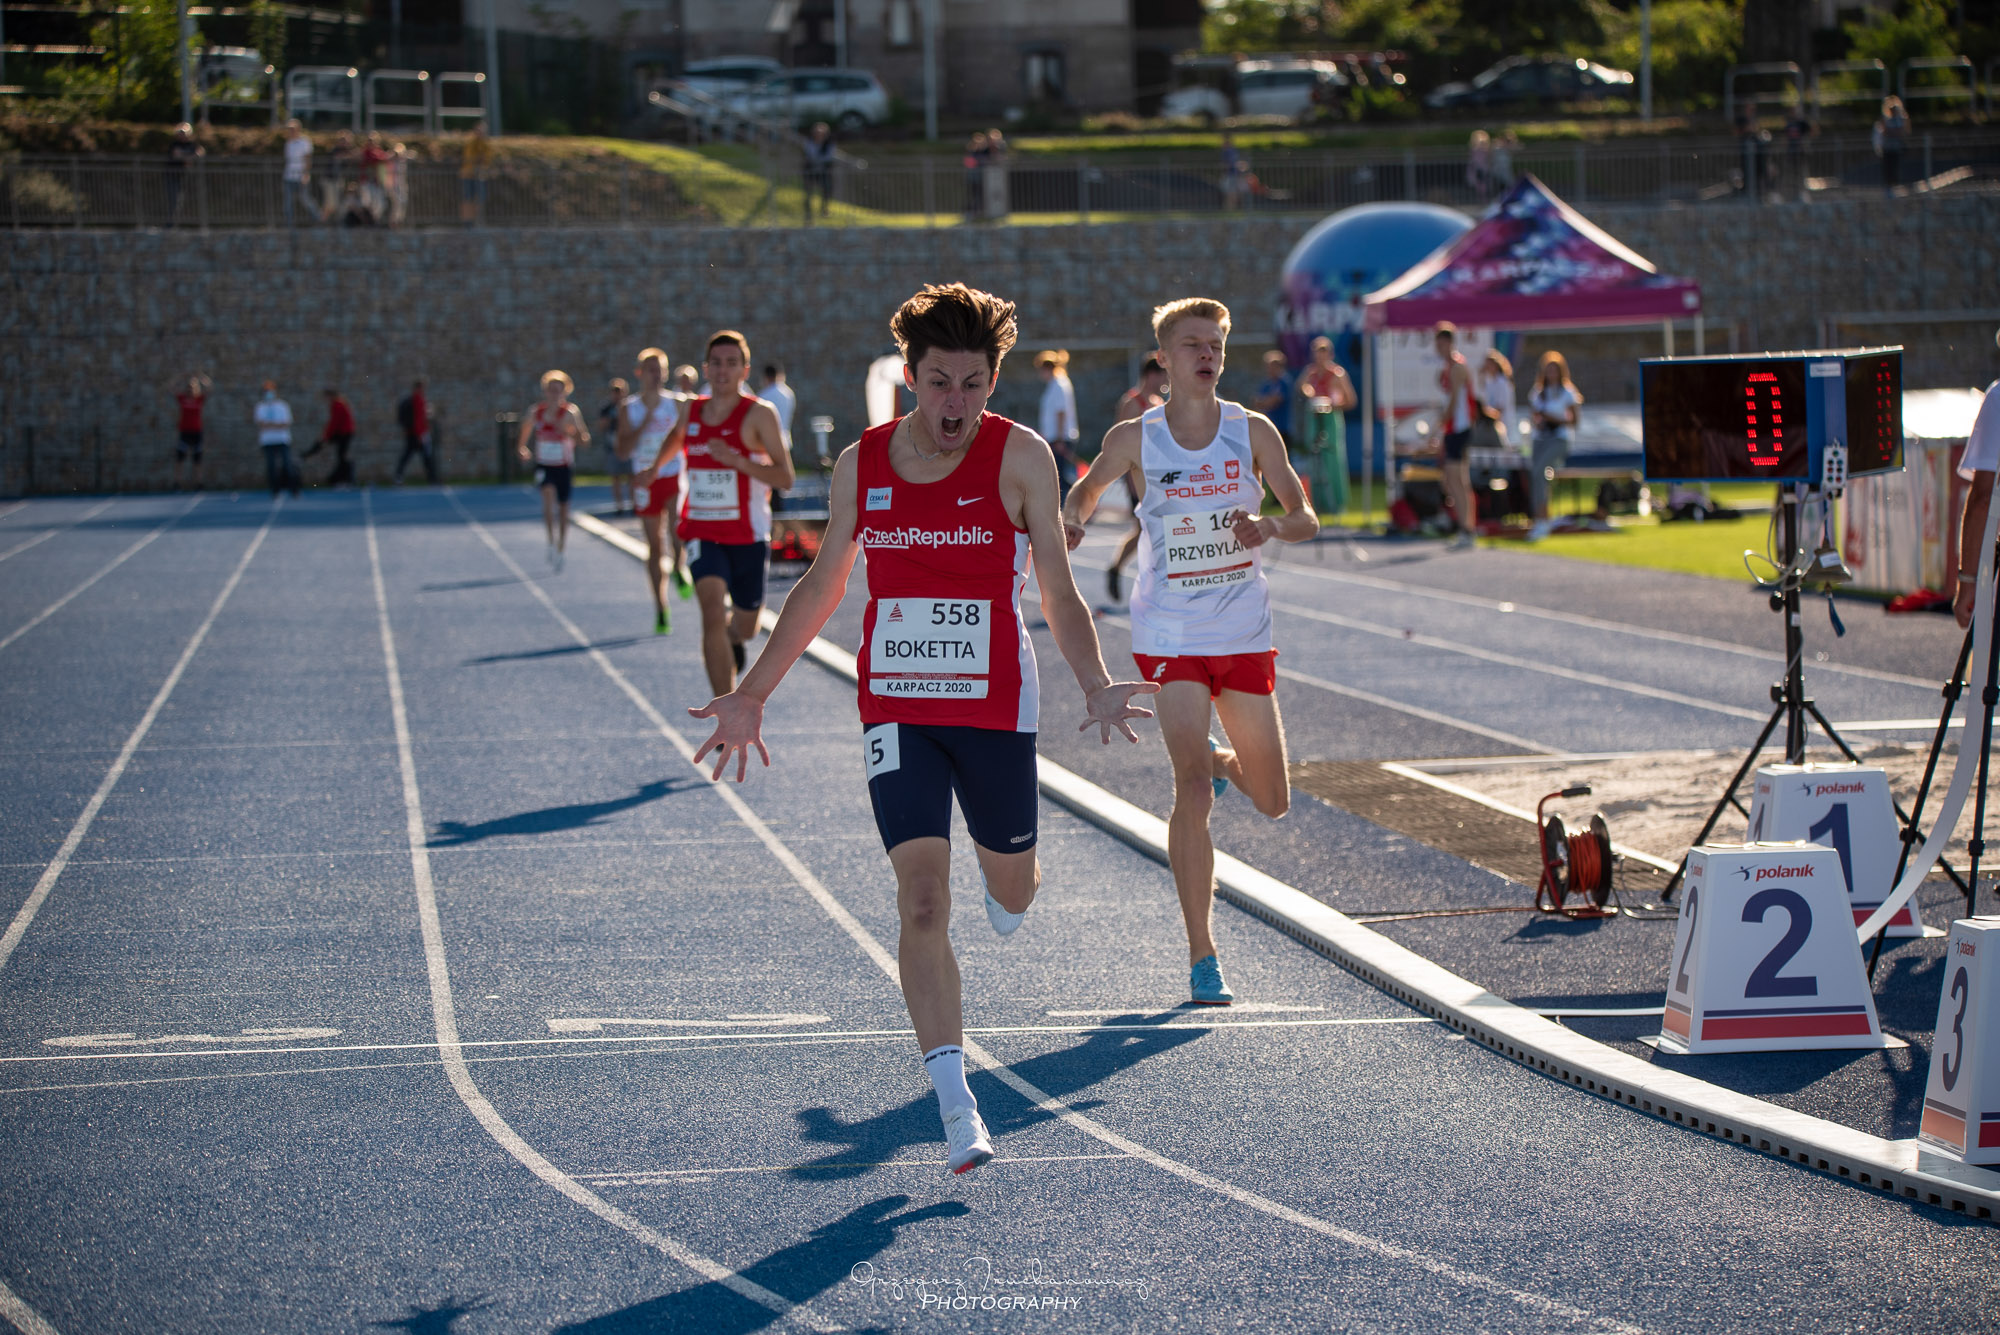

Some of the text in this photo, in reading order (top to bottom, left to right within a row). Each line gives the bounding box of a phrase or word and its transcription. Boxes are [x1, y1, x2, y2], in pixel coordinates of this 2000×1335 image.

[1745, 373, 1783, 466] 0
[1160, 471, 1182, 484] 4F
[1165, 482, 1239, 500] POLSKA
[863, 526, 993, 549] CzechRepublic
[1174, 527, 1195, 535] ORLEN
[1182, 575, 1224, 588] KARPACZ
[1227, 571, 1247, 582] 2020
[931, 603, 980, 626] 558
[885, 640, 975, 659] BOKETTA
[886, 682, 972, 693] KARPACZ 2020
[871, 738, 885, 766] 5
[1815, 781, 1865, 797] polanik
[1809, 803, 1854, 893] 1
[1755, 863, 1815, 882] polanik
[1675, 886, 1698, 995] 2
[1741, 888, 1818, 998] 2
[1942, 966, 1969, 1092] 3
